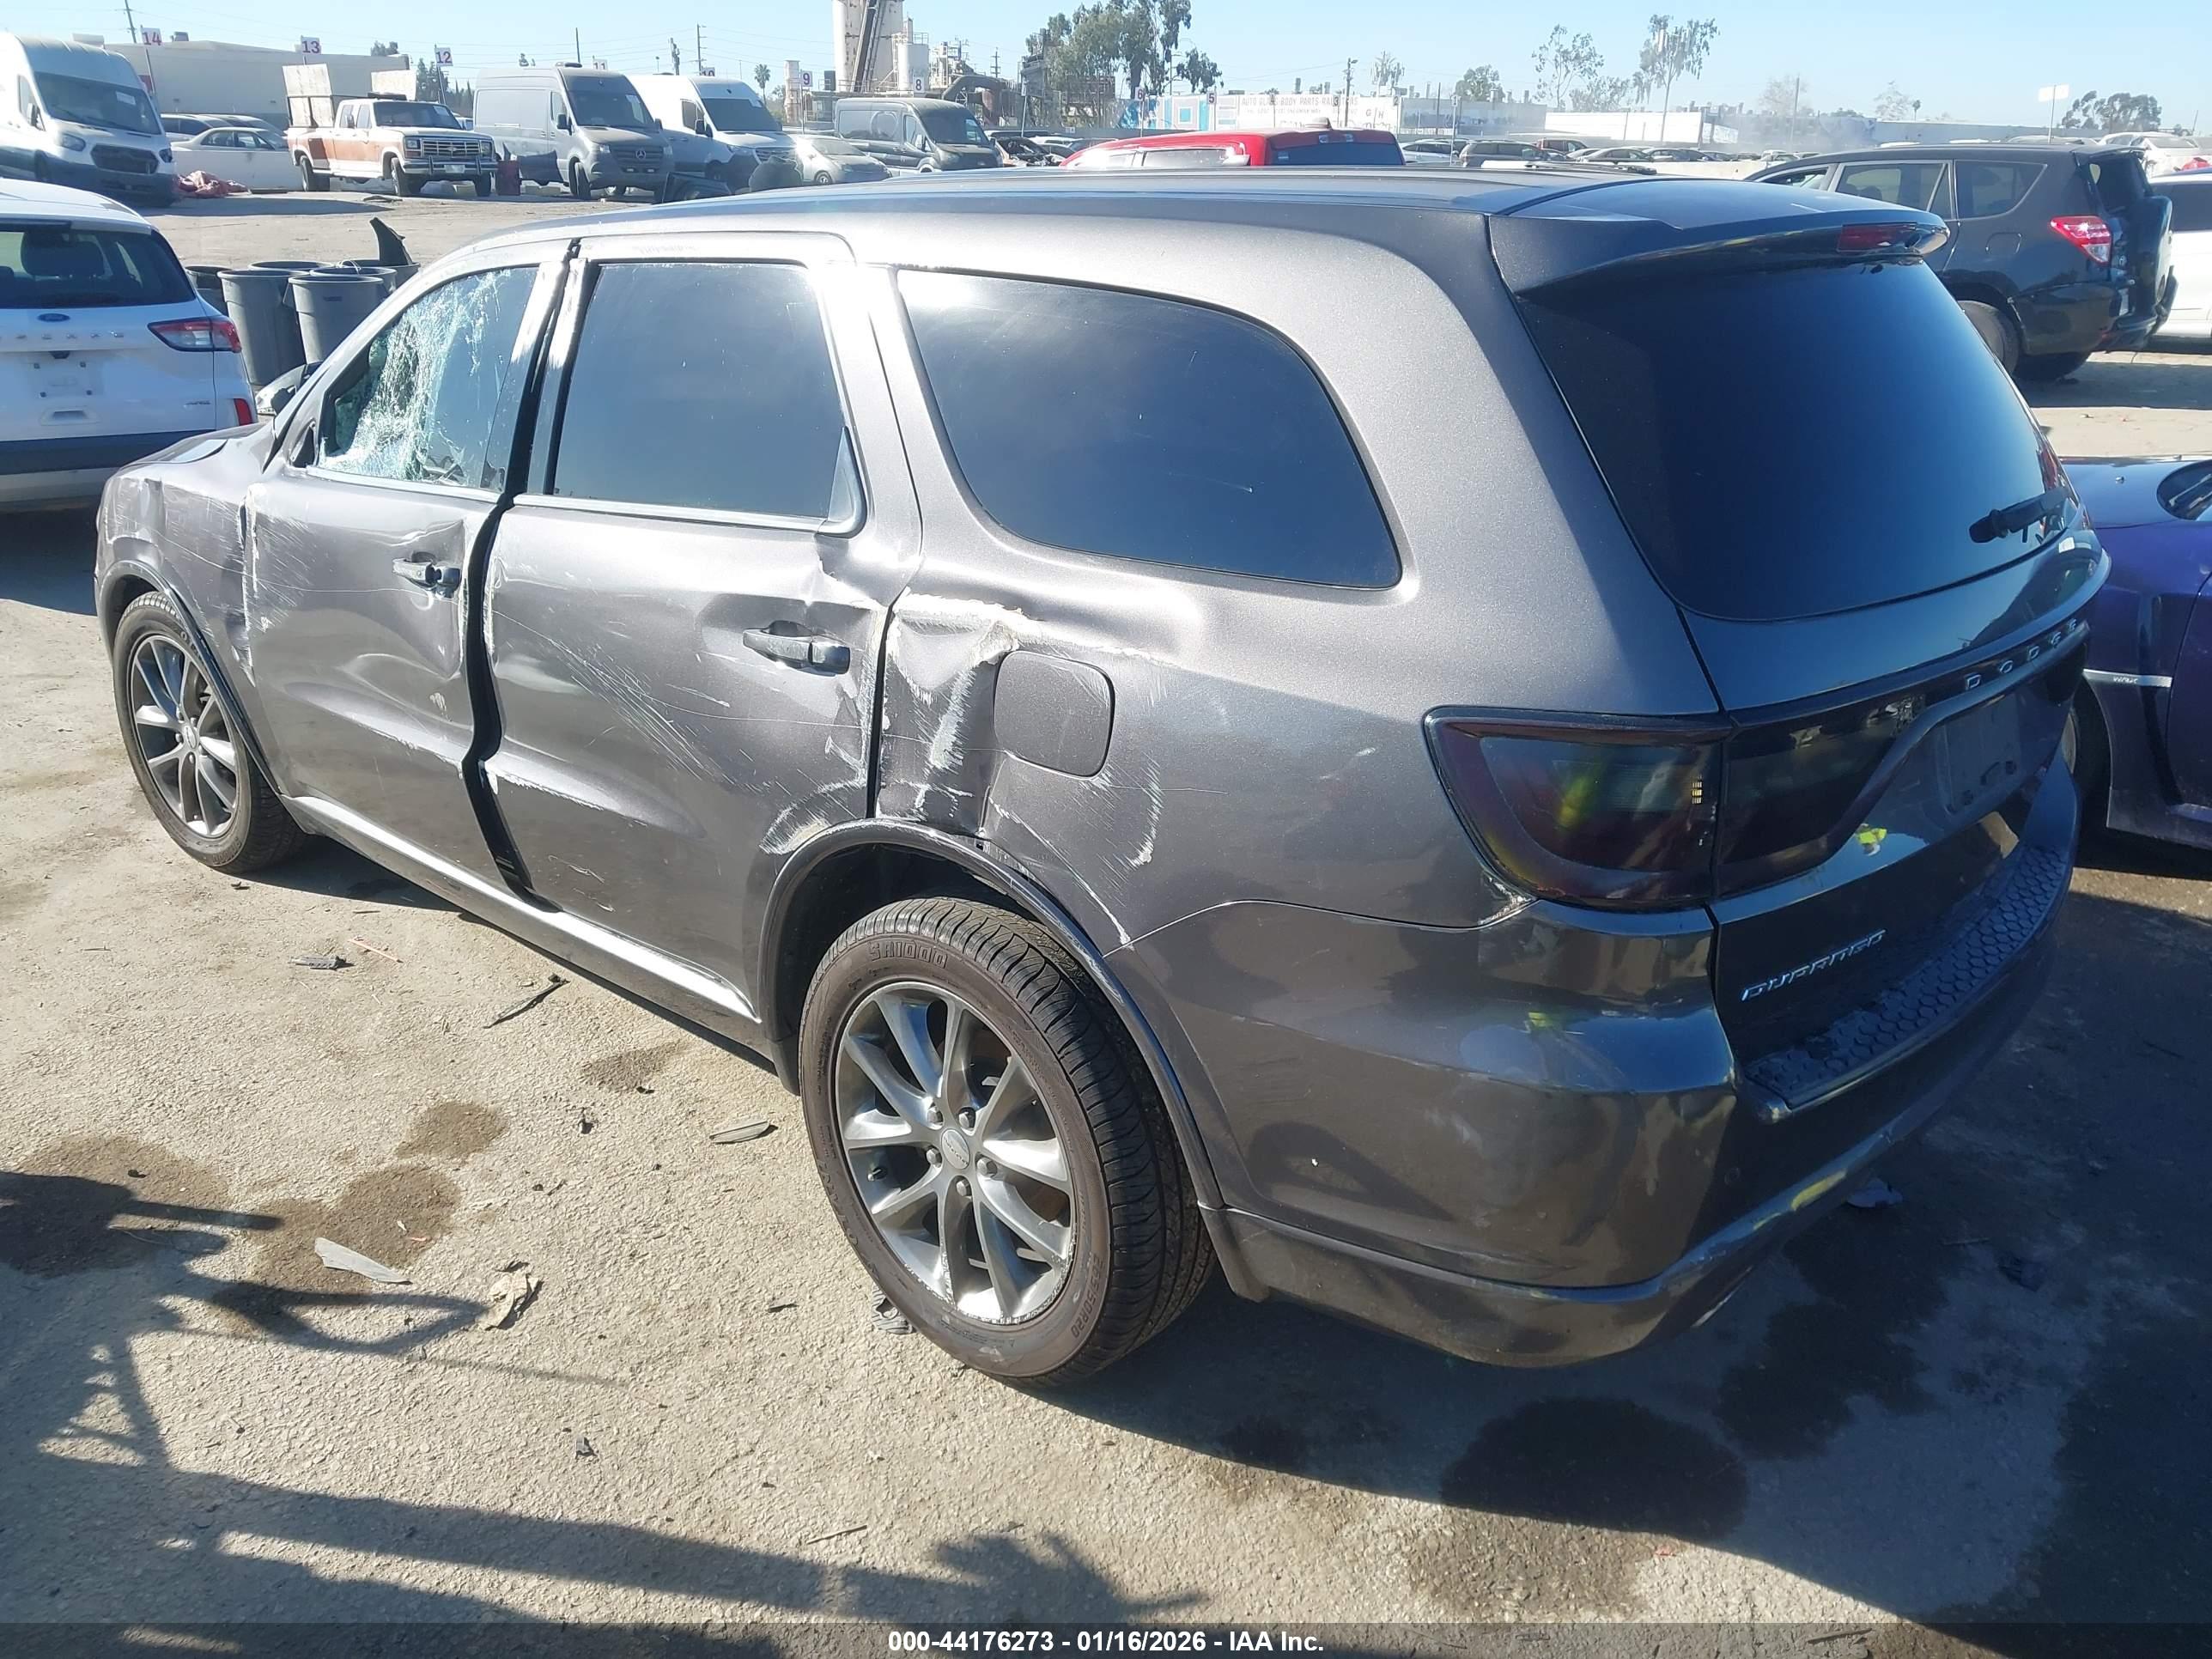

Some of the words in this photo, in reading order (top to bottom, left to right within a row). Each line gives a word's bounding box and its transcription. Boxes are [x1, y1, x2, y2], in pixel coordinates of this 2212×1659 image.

[143, 32, 161, 46] 14
[301, 40, 319, 53] 13
[436, 51, 453, 64] 12
[803, 72, 811, 85] 9
[915, 78, 922, 91] 8
[1137, 88, 1145, 100] 6
[1208, 93, 1215, 103] 5
[1394, 95, 1400, 106] 2
[1242, 97, 1257, 106] AUTO
[1280, 97, 1296, 106] BODY
[1299, 97, 1319, 106] PARTS
[1333, 96, 1340, 106] 3
[1966, 617, 2078, 690] DODGE
[1741, 929, 1887, 1001] DURANGO
